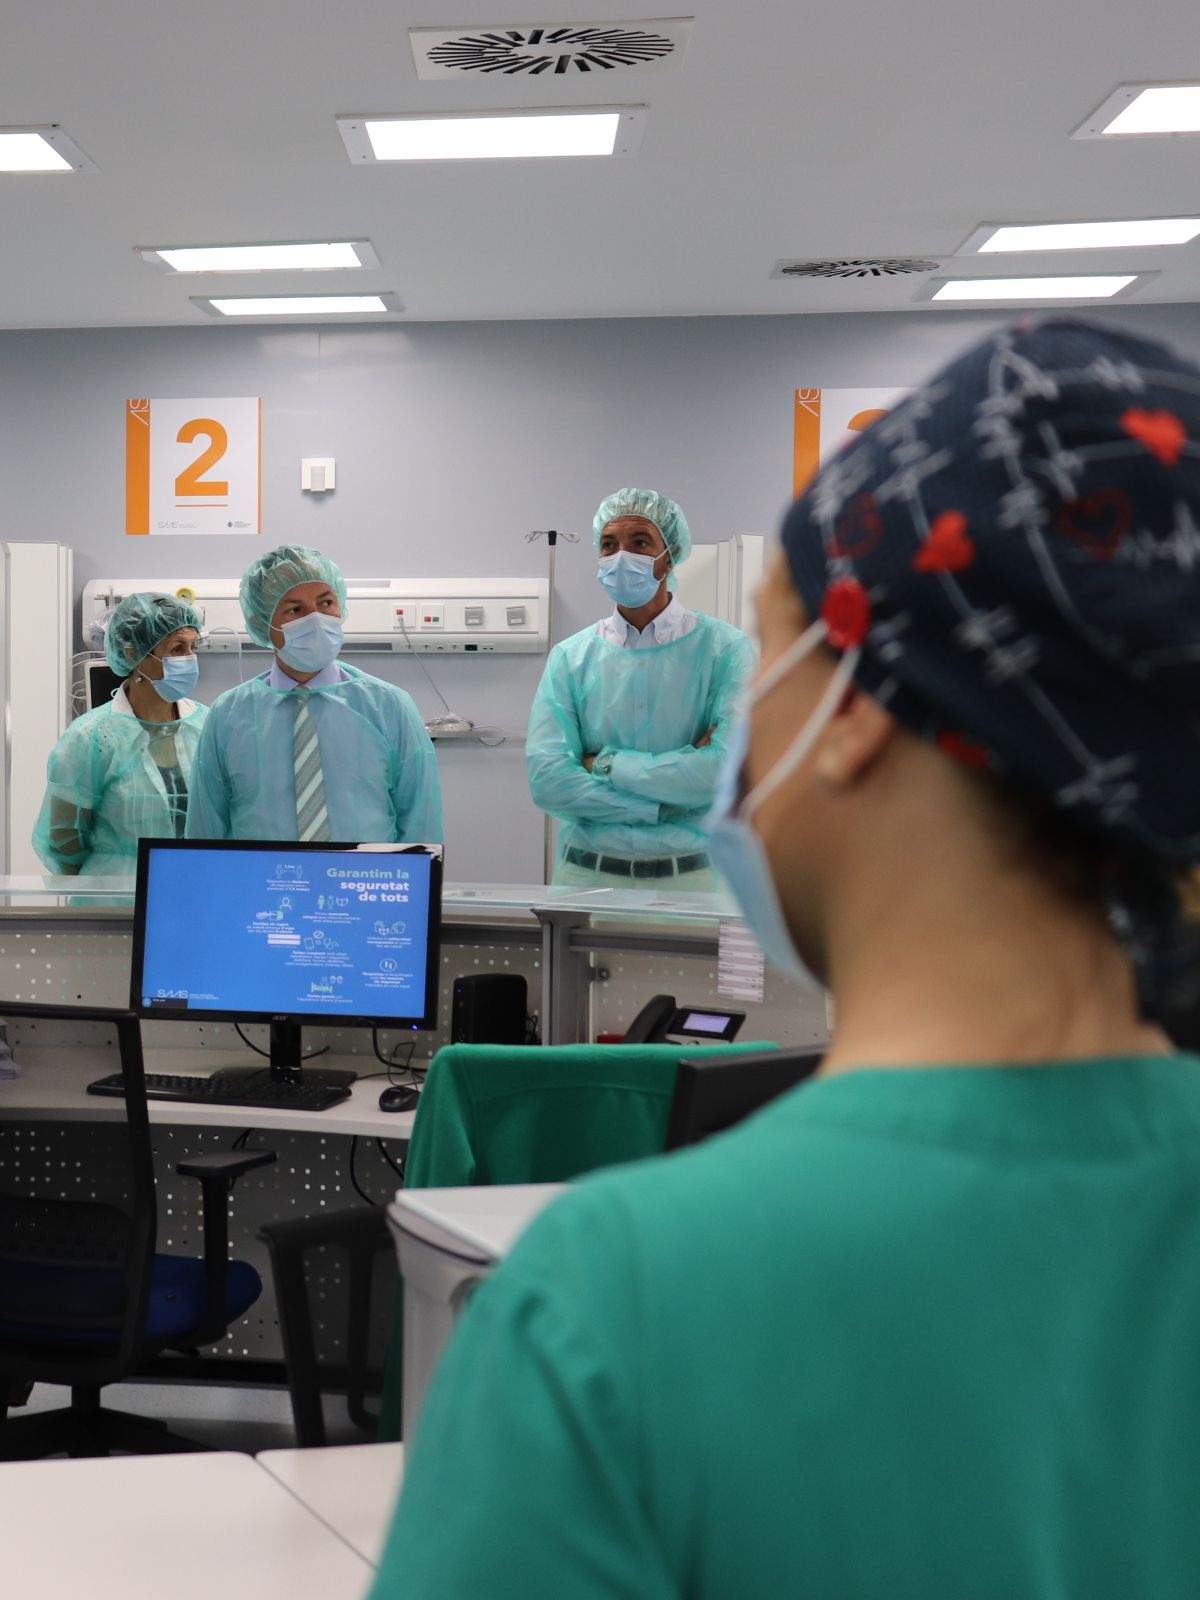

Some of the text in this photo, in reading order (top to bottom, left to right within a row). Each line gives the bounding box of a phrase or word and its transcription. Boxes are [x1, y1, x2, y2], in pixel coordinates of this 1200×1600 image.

[175, 418, 229, 496] 2
[326, 867, 410, 879] Garantim la
[340, 881, 410, 892] seguretat
[358, 891, 409, 903] de tots
